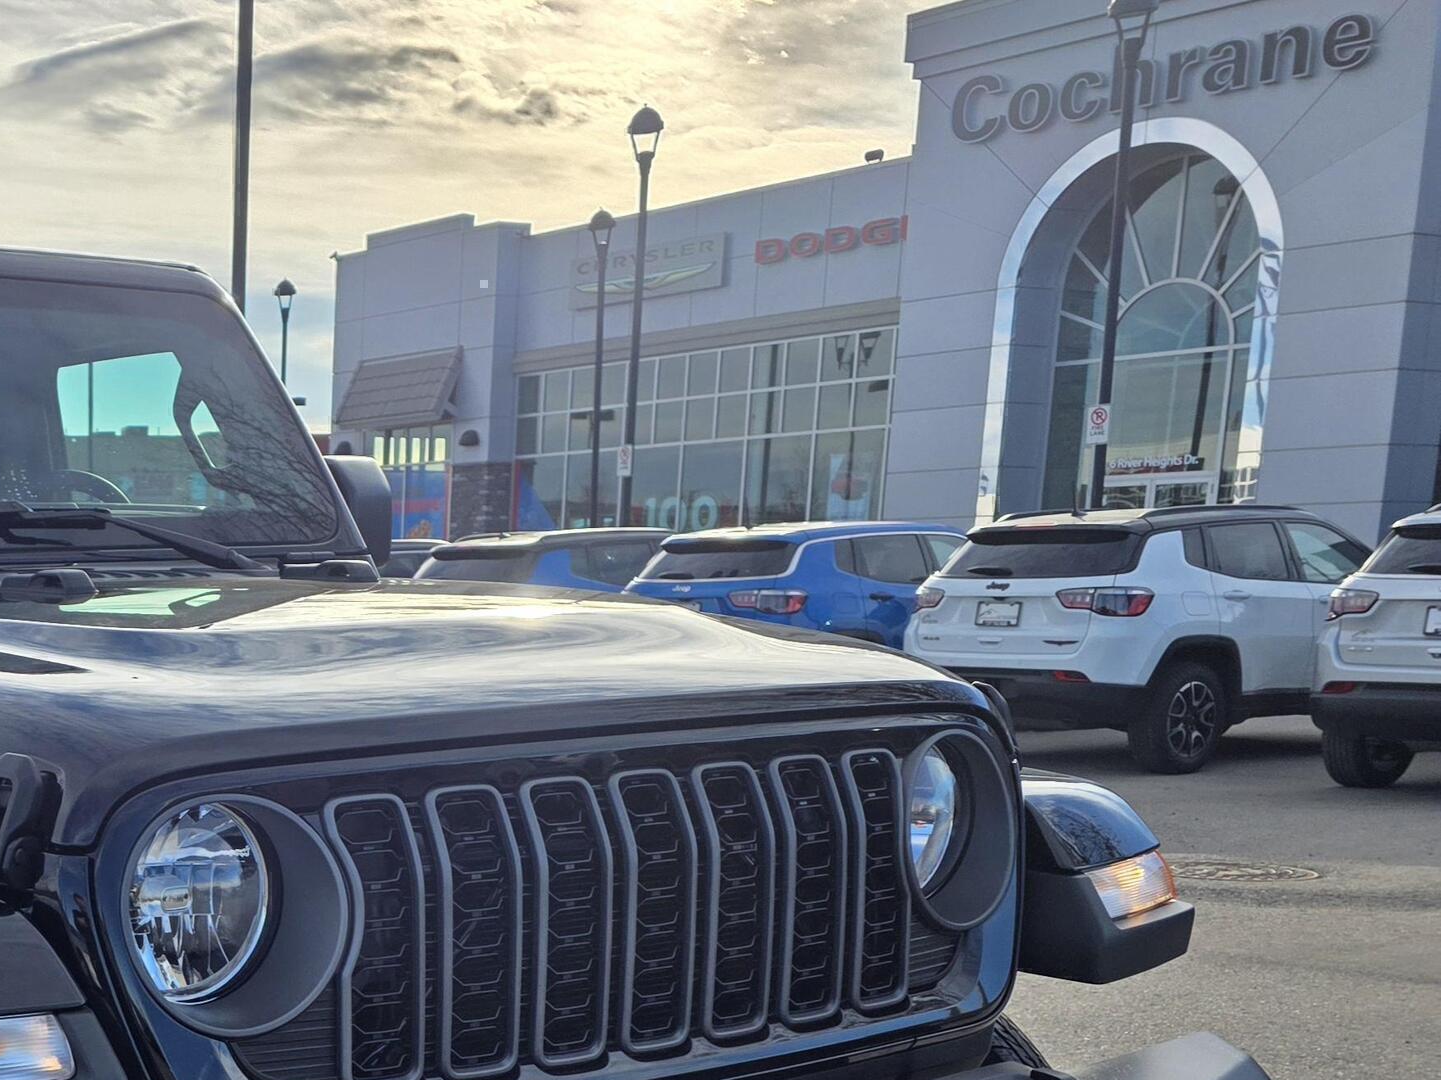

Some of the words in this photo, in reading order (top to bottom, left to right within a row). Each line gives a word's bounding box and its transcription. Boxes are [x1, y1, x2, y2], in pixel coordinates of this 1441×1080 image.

[952, 13, 1375, 143] Cochrane
[1117, 457, 1143, 468] River
[1143, 455, 1183, 469] Heights
[1184, 454, 1199, 465] Dr.
[985, 581, 1010, 591] Jeep
